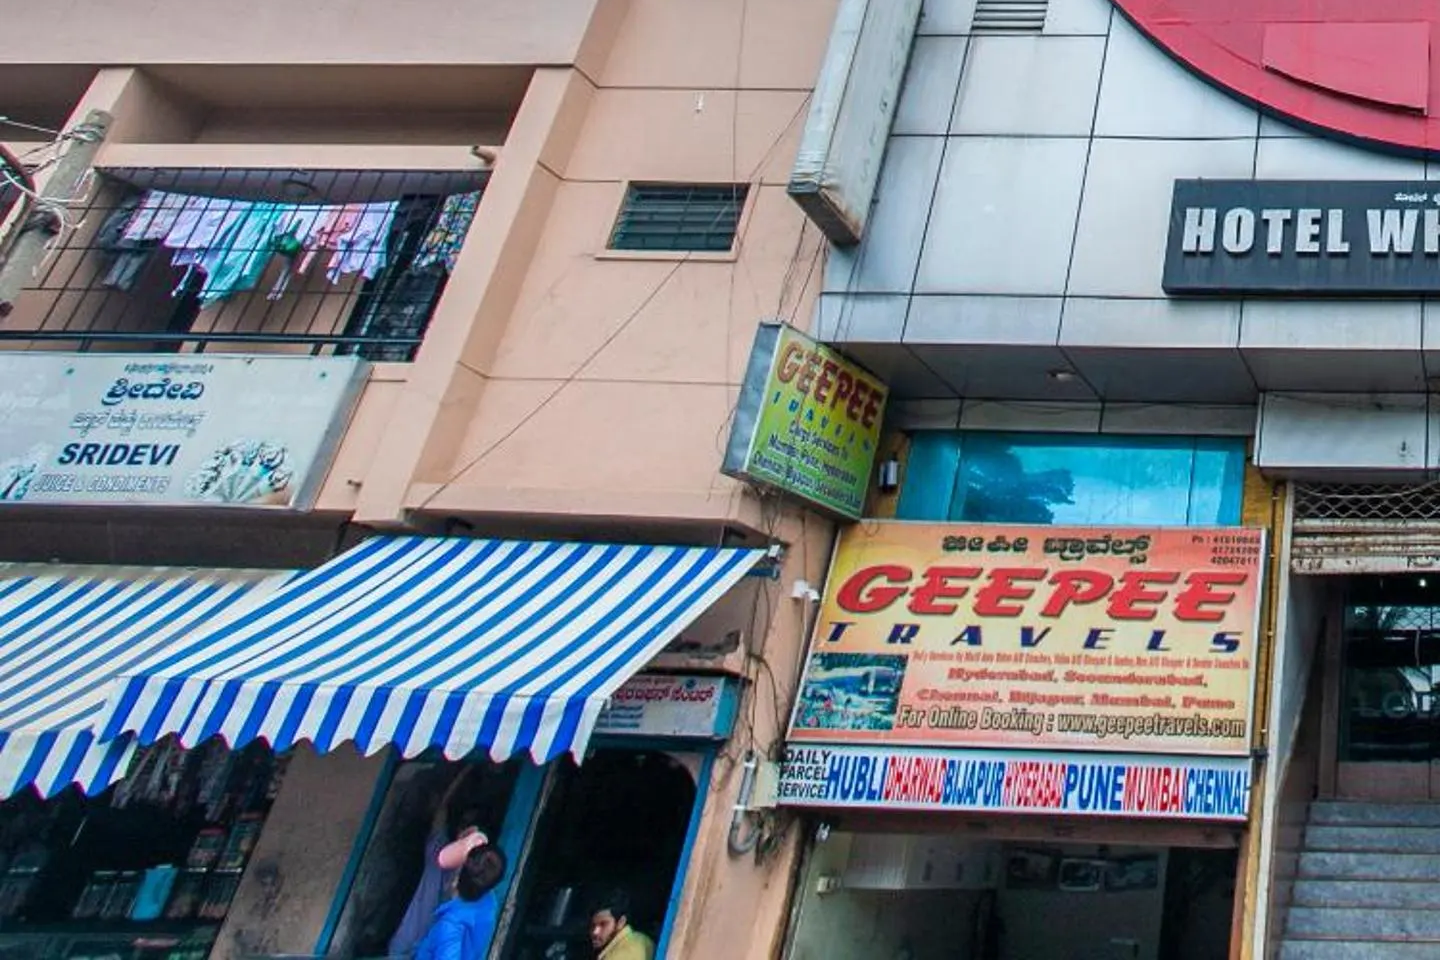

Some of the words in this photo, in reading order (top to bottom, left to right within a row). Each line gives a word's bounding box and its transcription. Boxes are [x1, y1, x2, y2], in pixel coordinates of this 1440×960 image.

[1182, 208, 1351, 254] HOTEL
[777, 343, 884, 430] GEEPEE
[57, 443, 181, 465] SRIDEVI
[836, 565, 1248, 622] GEEPEE
[824, 622, 1245, 653] TRAVELS
[900, 704, 926, 728] For
[928, 705, 978, 730] Online
[980, 707, 1044, 736] Booking
[1057, 712, 1246, 740] www.geepeetravels.com
[779, 764, 828, 781] PARCEL
[785, 749, 831, 764] DAILY
[826, 755, 889, 802] HUBLI
[942, 760, 1005, 807] BIJAPUR
[1062, 764, 1126, 811] PUNE
[1122, 766, 1189, 813] MUMBAI
[1184, 768, 1249, 815] CHENNAI
